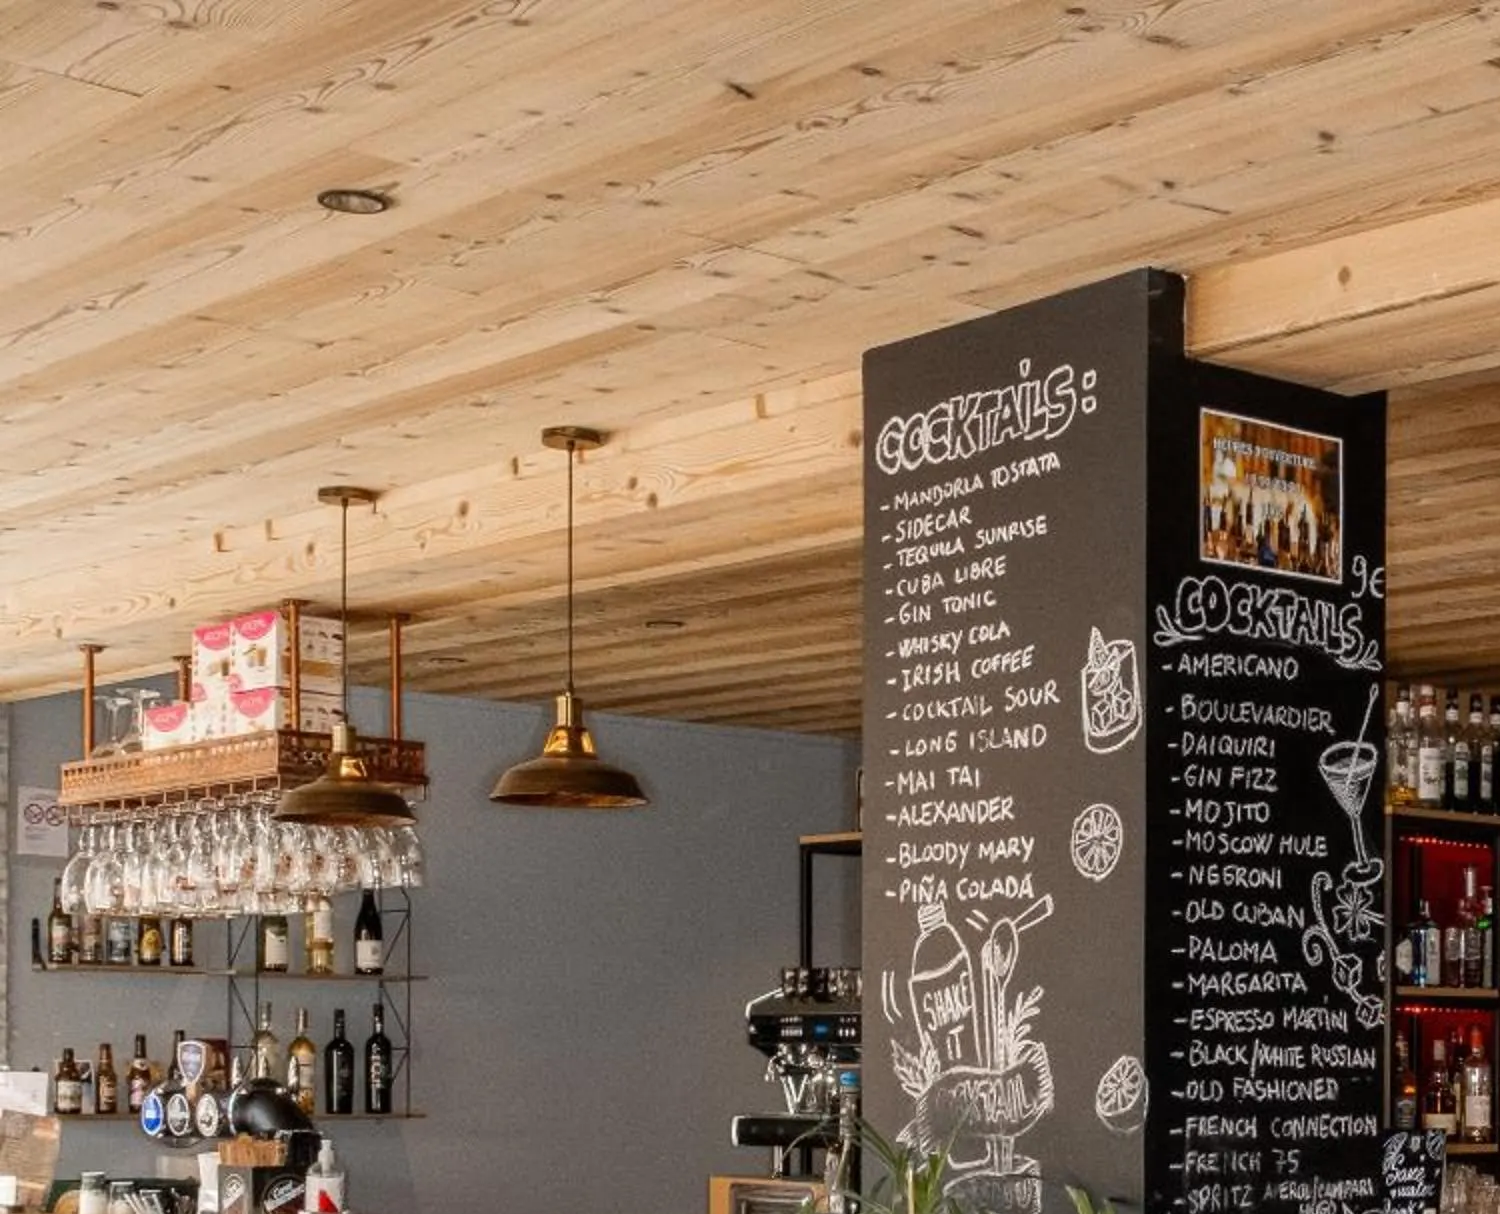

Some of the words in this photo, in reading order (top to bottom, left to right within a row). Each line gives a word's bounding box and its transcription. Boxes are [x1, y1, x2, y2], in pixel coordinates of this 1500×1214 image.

[894, 474, 983, 511] MANDORLA
[990, 452, 1061, 488] TOSTATA
[895, 506, 972, 543] SIDECAR
[896, 537, 965, 567] TEQUILA
[975, 515, 1048, 549] SUNRISE
[896, 574, 944, 597] CUBA
[955, 556, 1007, 584] LIBRE
[899, 604, 931, 625] GIN
[942, 590, 997, 615] TONIC
[1175, 575, 1363, 668] COCKTAILS
[898, 631, 962, 658] WHISKY
[968, 620, 1011, 645] COLA
[901, 663, 961, 692] IRISH
[971, 645, 1035, 679] COFFEE
[1177, 653, 1299, 680] AMERICANO
[903, 695, 993, 722] COCKTAIL
[1005, 680, 1061, 712] SOUR
[1181, 693, 1336, 736] BOULEVARDIER
[905, 731, 957, 757] LONG
[969, 724, 1047, 752] ISLAND
[1182, 731, 1276, 758] DAIQUIRI
[897, 770, 935, 795] MAI
[947, 765, 980, 789] TAI
[1183, 764, 1222, 788] GIN
[1230, 766, 1279, 793] FIZZ
[898, 796, 1015, 827] ALEXANDER
[1184, 798, 1270, 828] MOJITO
[900, 841, 970, 871] BLOODY
[978, 836, 1035, 863] MARY
[1186, 828, 1274, 855] MOSCOW
[900, 873, 948, 903] PIÑA
[956, 873, 1035, 901] COLADA
[1189, 864, 1282, 889] NEGRONI
[1185, 898, 1224, 924] OLD
[1232, 902, 1305, 928] CUBAN
[1189, 936, 1278, 964] PALOMA
[1188, 971, 1308, 998] MARGARITA
[923, 971, 972, 1031] SHAKE
[1190, 1008, 1275, 1033] ESPRESSO
[946, 1024, 965, 1060] IT
[1311, 1044, 1376, 1069] RUSSIAN
[1186, 1079, 1224, 1102] OLD
[1232, 1077, 1340, 1102] FASHIONED
[1185, 1114, 1257, 1139] FRENCH
[1270, 1113, 1377, 1140] CONNECTION
[1271, 1148, 1300, 1174] 75
